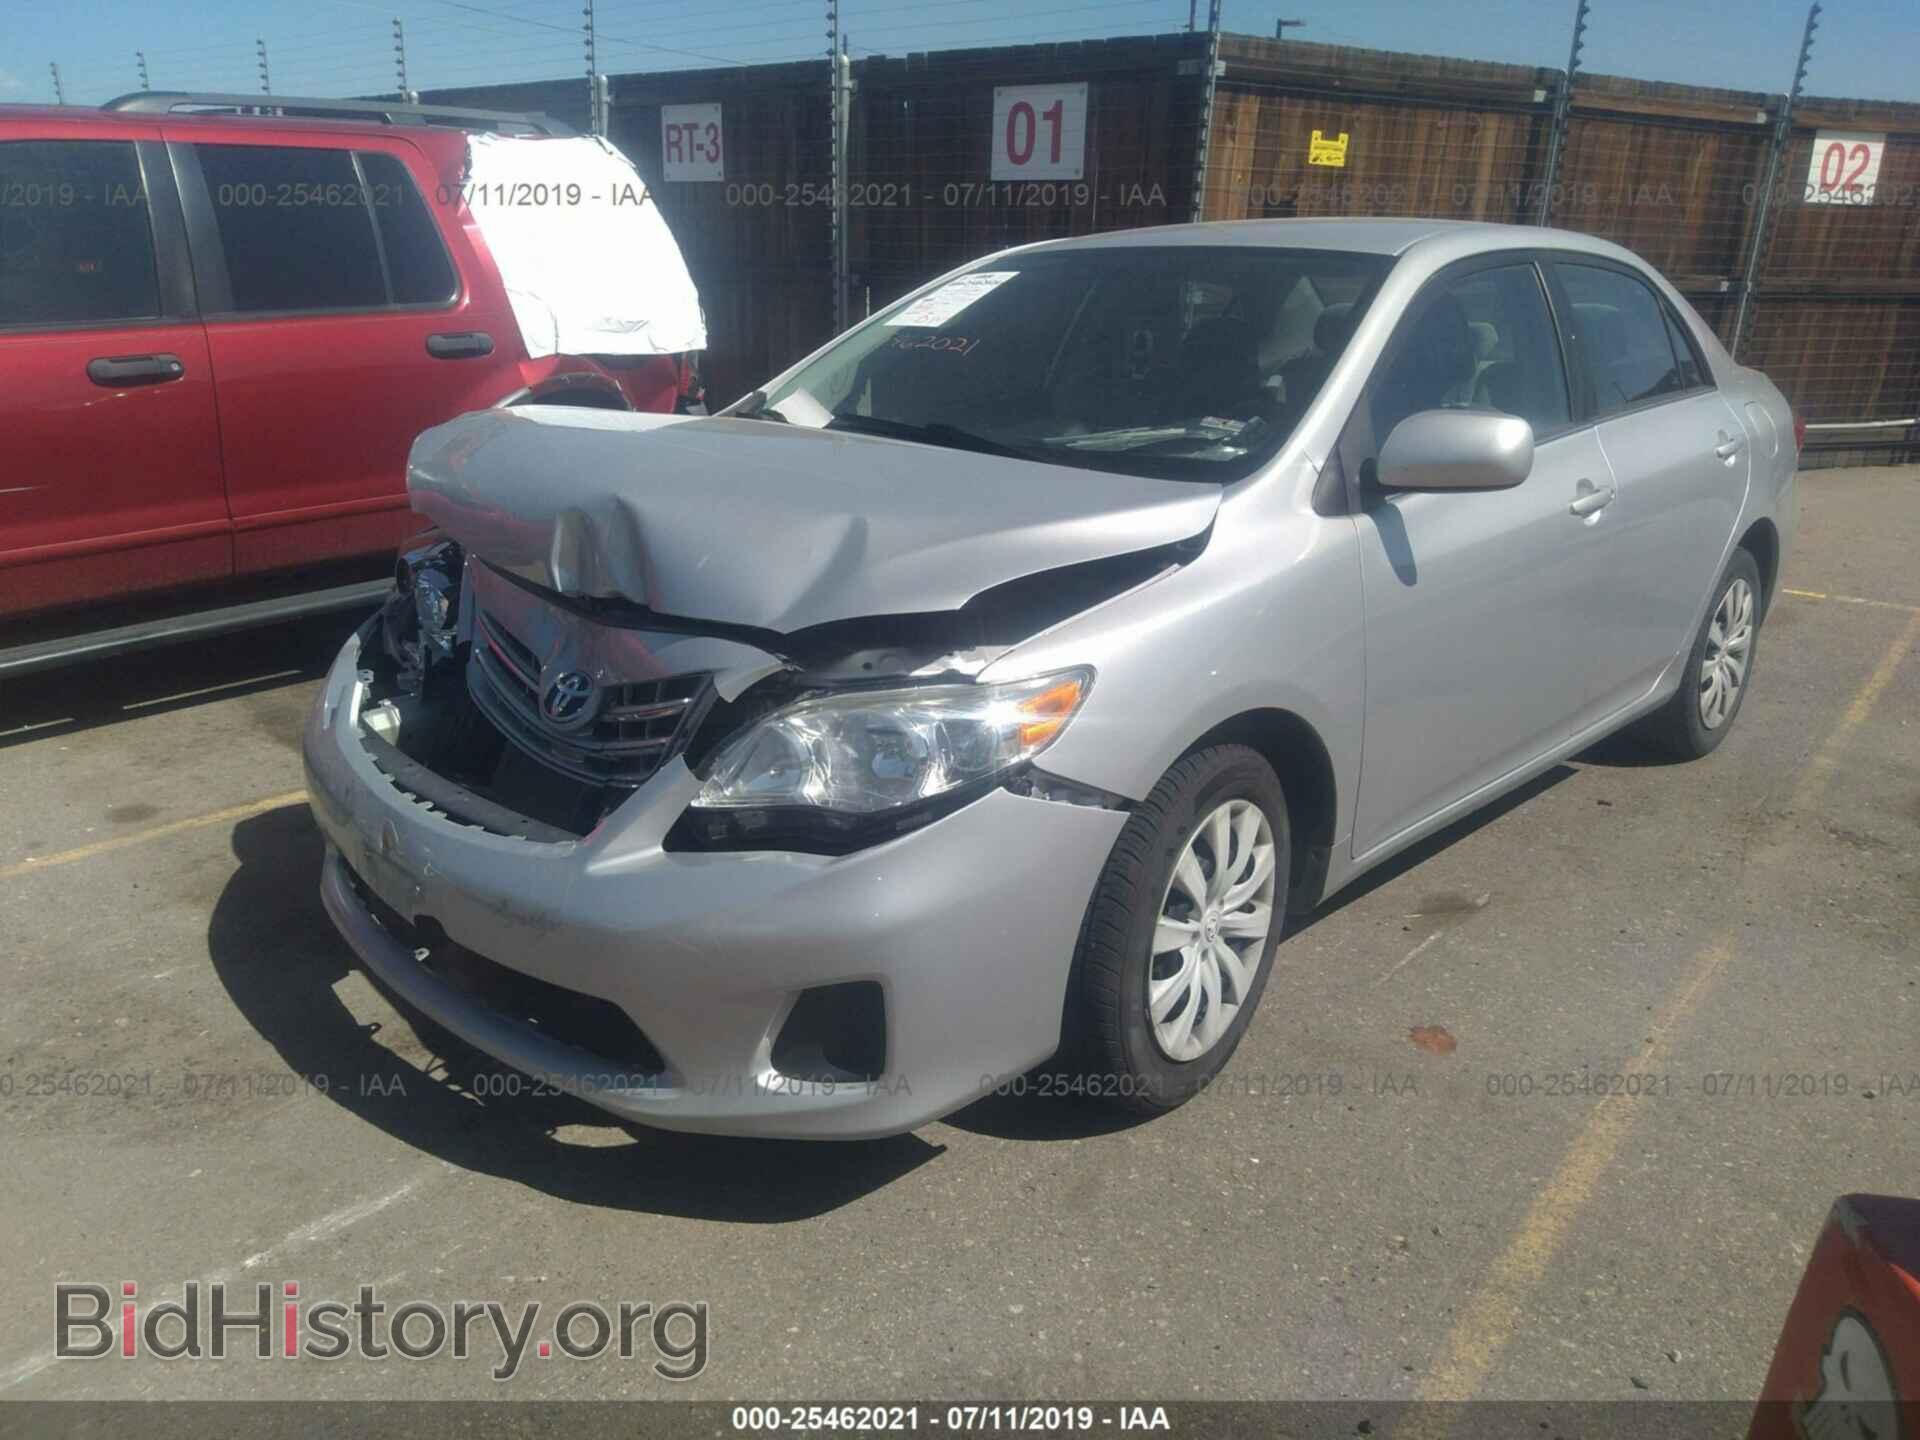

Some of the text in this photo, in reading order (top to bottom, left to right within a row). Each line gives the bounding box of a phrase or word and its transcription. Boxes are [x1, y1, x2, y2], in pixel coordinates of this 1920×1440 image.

[665, 121, 720, 163] RT-3
[1007, 100, 1063, 166] 01
[1821, 142, 1871, 192] 02
